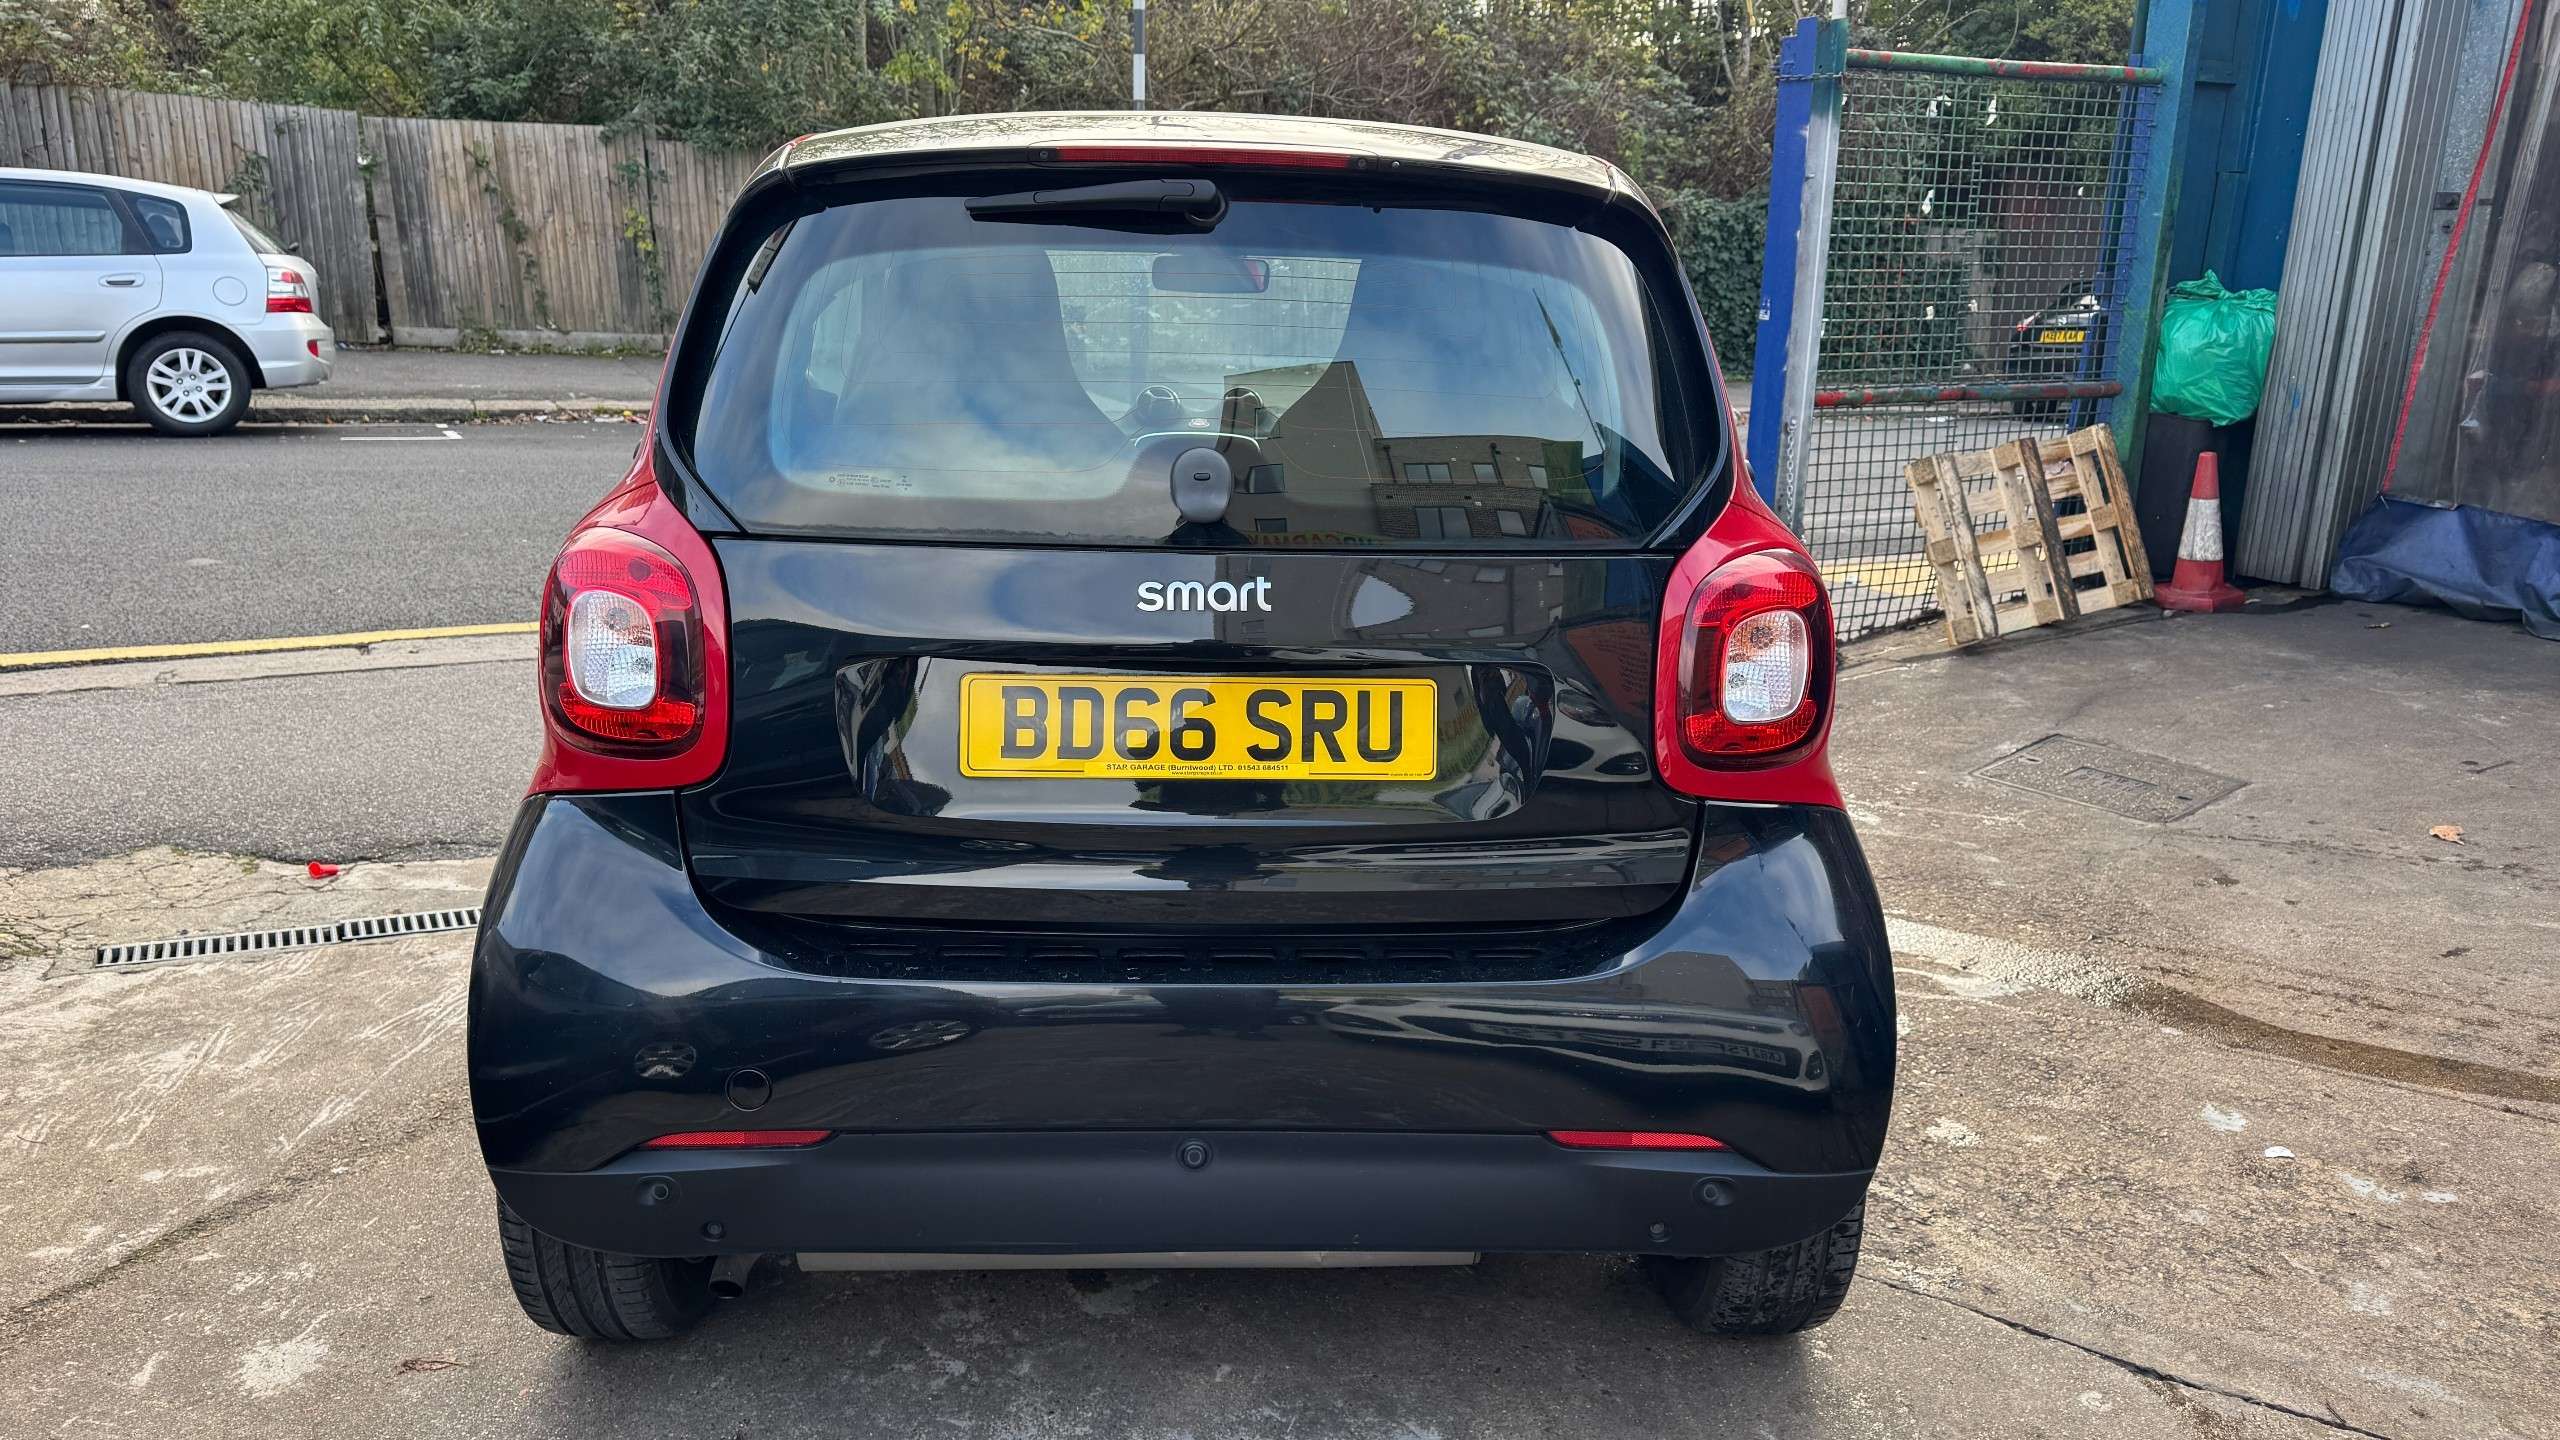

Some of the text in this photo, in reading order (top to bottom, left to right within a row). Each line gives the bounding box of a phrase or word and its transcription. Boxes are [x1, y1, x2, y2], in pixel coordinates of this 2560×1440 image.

[1136, 576, 1273, 612] smart
[1000, 685, 1403, 763] BD66 SRU
